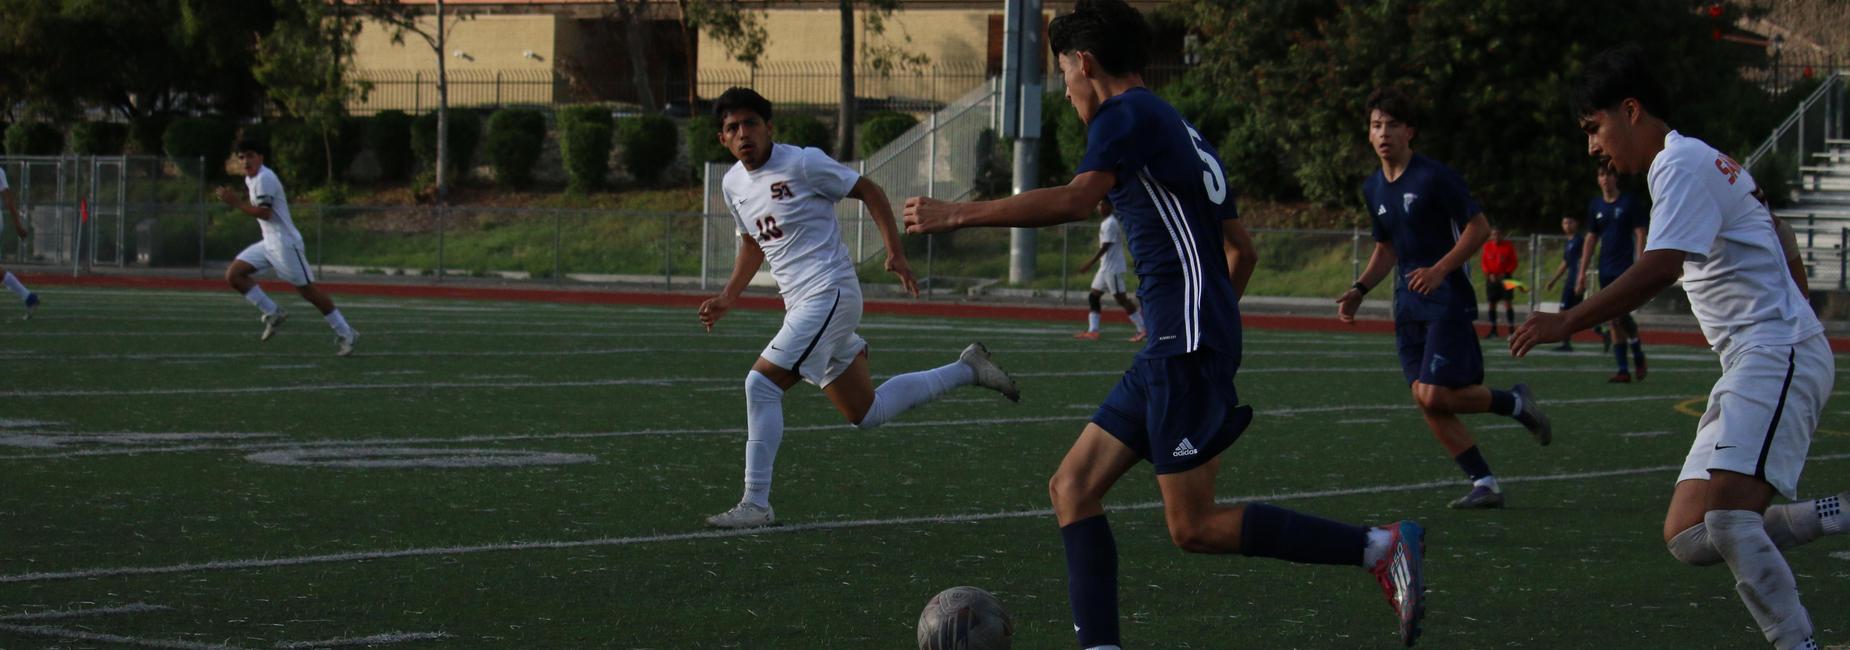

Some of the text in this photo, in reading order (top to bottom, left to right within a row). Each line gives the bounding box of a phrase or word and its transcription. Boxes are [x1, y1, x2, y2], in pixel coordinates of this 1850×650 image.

[1181, 119, 1227, 205] 5
[770, 181, 793, 200] SA
[1172, 448, 1198, 457] adidas
